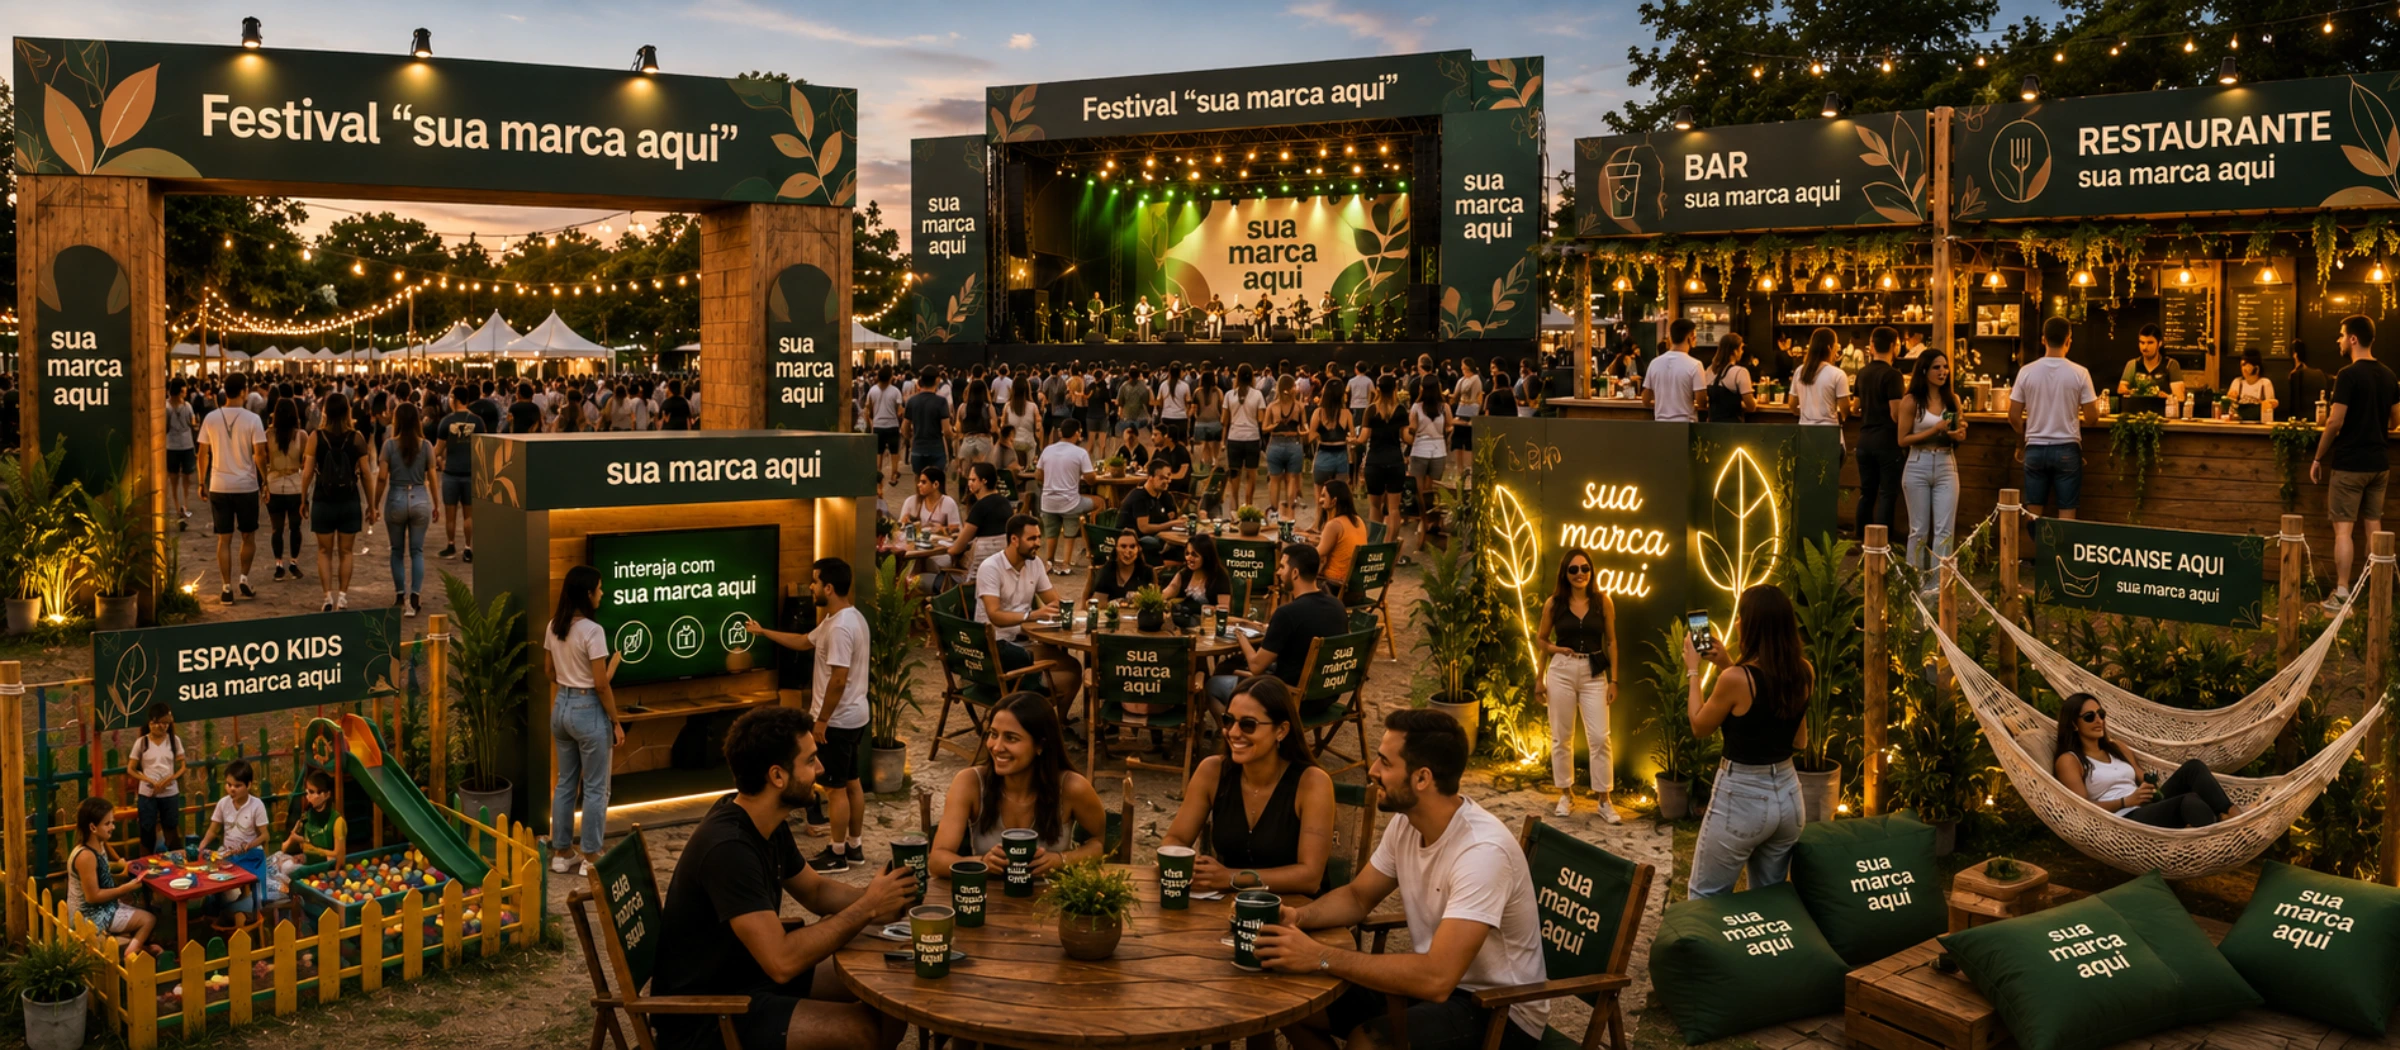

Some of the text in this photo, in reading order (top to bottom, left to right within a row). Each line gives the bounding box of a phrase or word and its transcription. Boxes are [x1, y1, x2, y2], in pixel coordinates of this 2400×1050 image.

[1083, 73, 1398, 121] Festival “sua marca aqui”
[203, 94, 738, 170] Festival “sua marca aqui”
[2079, 111, 2331, 156] RESTAURANTE
[1685, 151, 1748, 181] BAR
[2079, 153, 2275, 188] sua marca aqui
[1465, 174, 1504, 191] sua
[1685, 179, 1840, 209] sua marca aqui
[928, 197, 960, 212] sua
[1456, 197, 1524, 215] marca
[922, 217, 975, 233] marca
[1247, 219, 1297, 240] sua
[1464, 216, 1512, 244] aqui
[929, 235, 966, 259] aqui
[1229, 243, 1318, 265] marca
[1243, 264, 1303, 296] aqui
[51, 331, 97, 350] sua
[779, 337, 814, 353] sua
[48, 359, 123, 377] marca
[776, 361, 834, 378] marca
[54, 381, 109, 411] aqui
[781, 382, 824, 408] aqui
[607, 449, 821, 485] sua marca aqui
[1583, 482, 1642, 511] sua
[1560, 524, 1669, 556] marca
[614, 558, 715, 579] interaja com
[2074, 543, 2224, 578] DESCANSE AQUI
[614, 575, 756, 605] sua marca aqui
[1597, 563, 1650, 598] qui
[2143, 584, 2186, 599] marca
[2189, 588, 2219, 604] aqui
[179, 635, 342, 672] ESPAÇO KIDS
[1127, 650, 1158, 662] sua
[179, 662, 341, 701] sua marca aqui
[1115, 664, 1171, 678] marca
[1123, 678, 1161, 695] aqui
[1856, 857, 1892, 872] sua
[1557, 866, 1593, 898] sua
[1851, 871, 1915, 893] marca
[1537, 885, 1601, 932] marca
[1867, 887, 1912, 911] aqui
[2299, 889, 2344, 910] sua
[1723, 911, 1764, 926] sua
[2273, 901, 2354, 932] marca
[1541, 919, 1586, 955] aqui
[1722, 919, 1792, 941] marca
[2048, 923, 2093, 942] sua
[2272, 924, 2333, 950] aqui
[1746, 934, 1794, 956] aqui
[2048, 932, 2127, 962] marca
[2078, 950, 2130, 978] aqui
